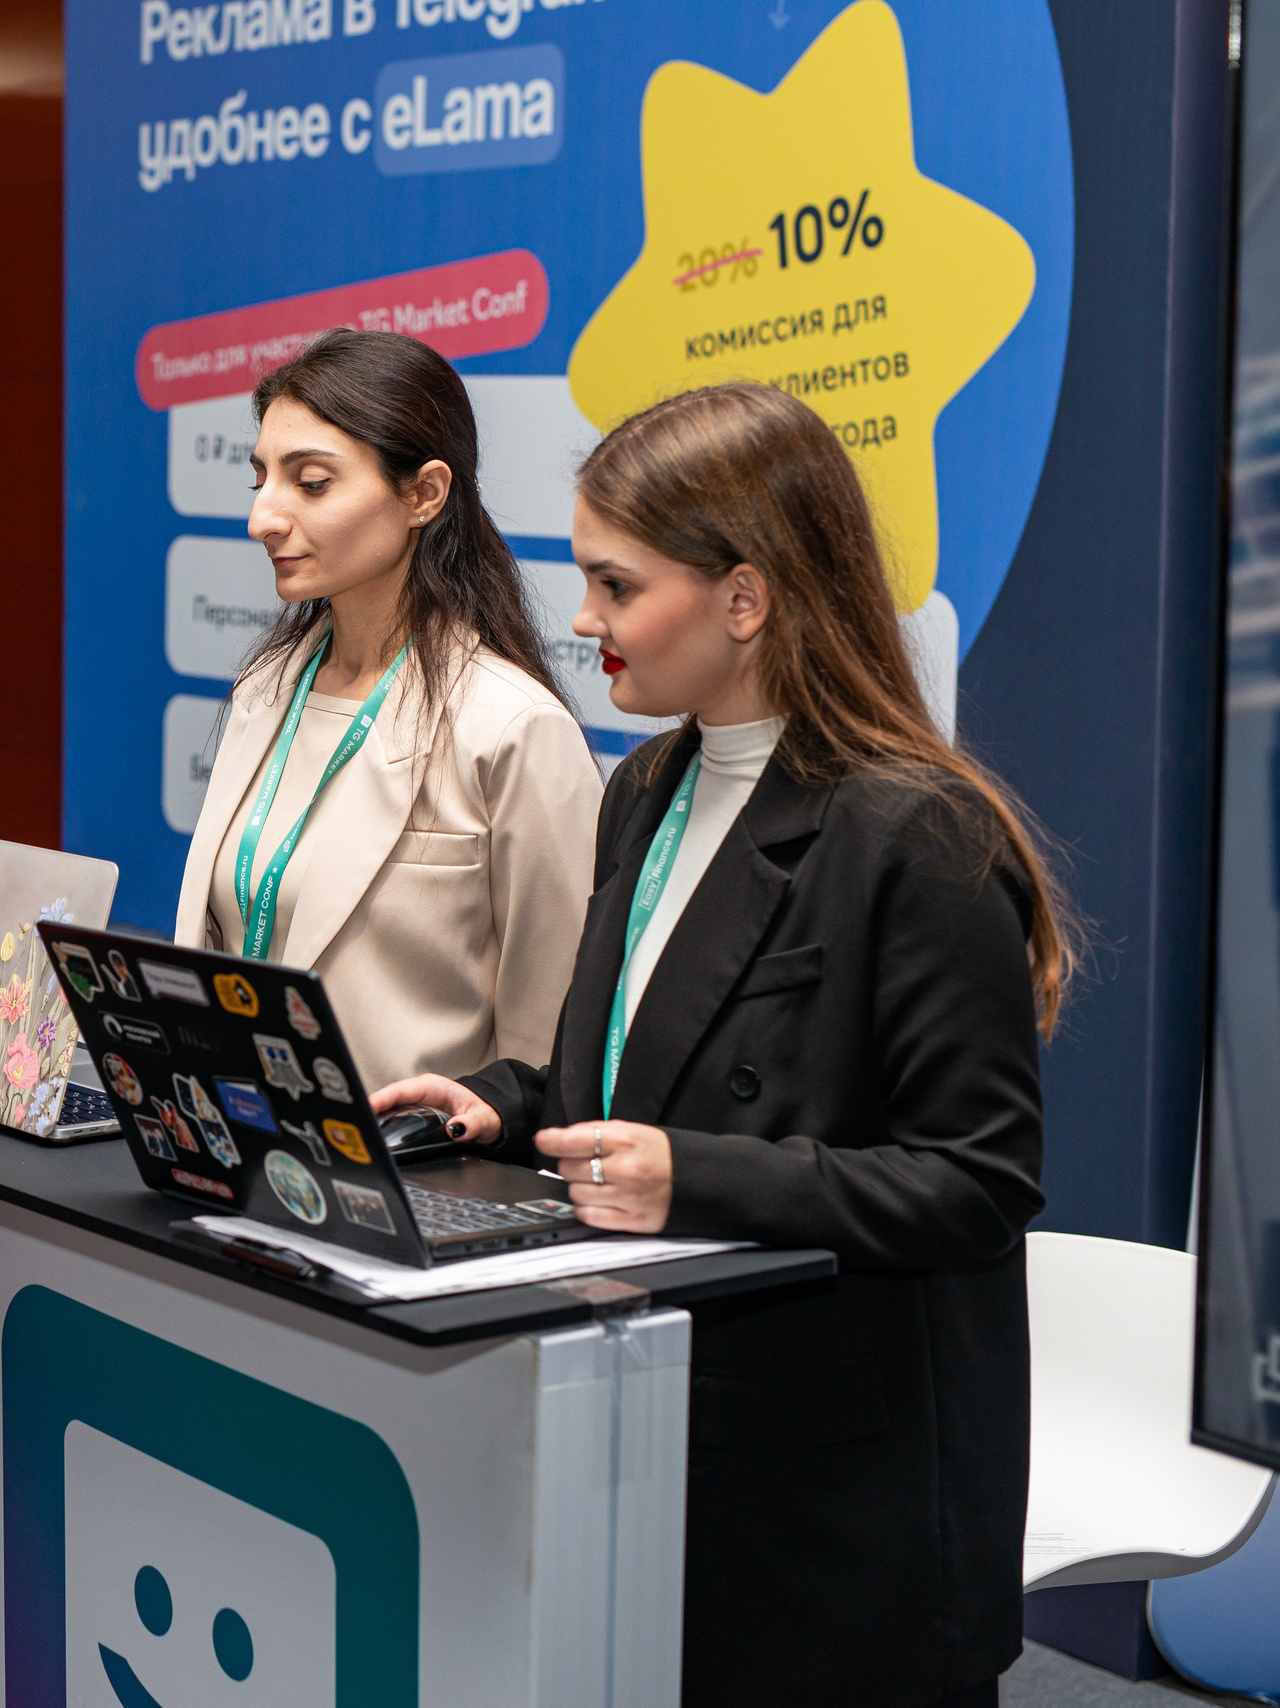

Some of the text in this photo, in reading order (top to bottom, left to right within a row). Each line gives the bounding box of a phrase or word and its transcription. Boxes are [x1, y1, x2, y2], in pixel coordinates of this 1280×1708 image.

[140, 0, 332, 64] Реклама
[139, 75, 555, 192] удобнее с eLama
[768, 188, 885, 269] 10%
[393, 296, 469, 335] Market
[471, 279, 529, 322] Conf
[685, 295, 887, 361] комиссия для
[328, 728, 365, 775] TG MARKET
[256, 764, 280, 814] TG MARKET
[651, 827, 677, 880] Finance.ru
[251, 875, 274, 957] MARKET CONF
